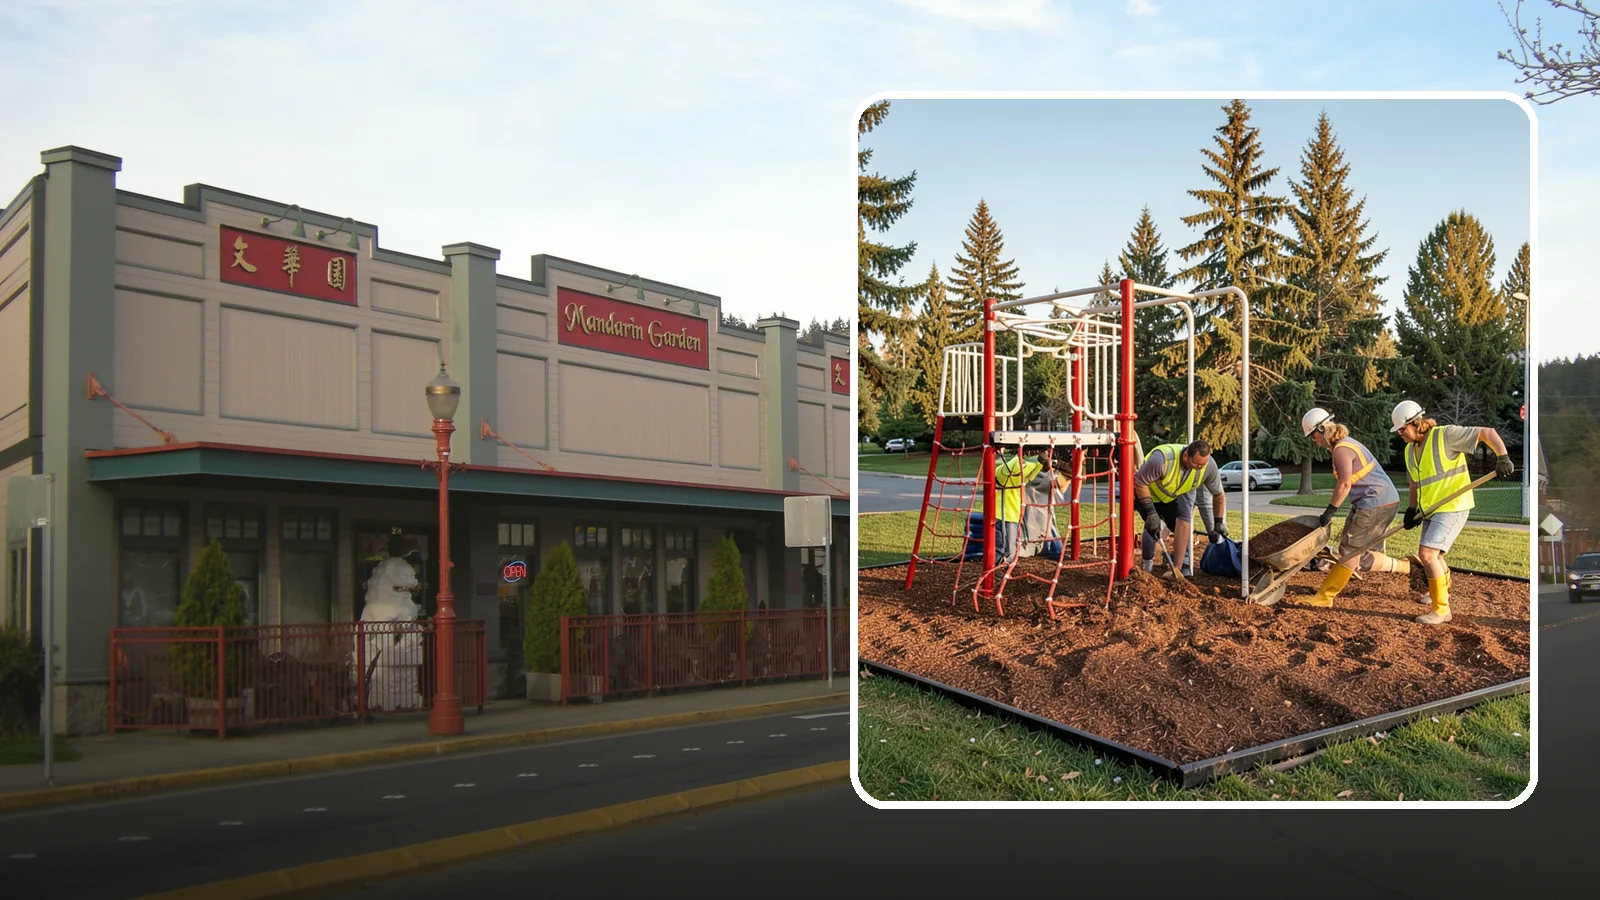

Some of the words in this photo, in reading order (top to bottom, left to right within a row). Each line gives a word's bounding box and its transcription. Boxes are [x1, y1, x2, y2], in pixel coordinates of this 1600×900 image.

[564, 302, 644, 341] Mandarin
[647, 320, 701, 352] Garden
[503, 565, 527, 578] OPEN
